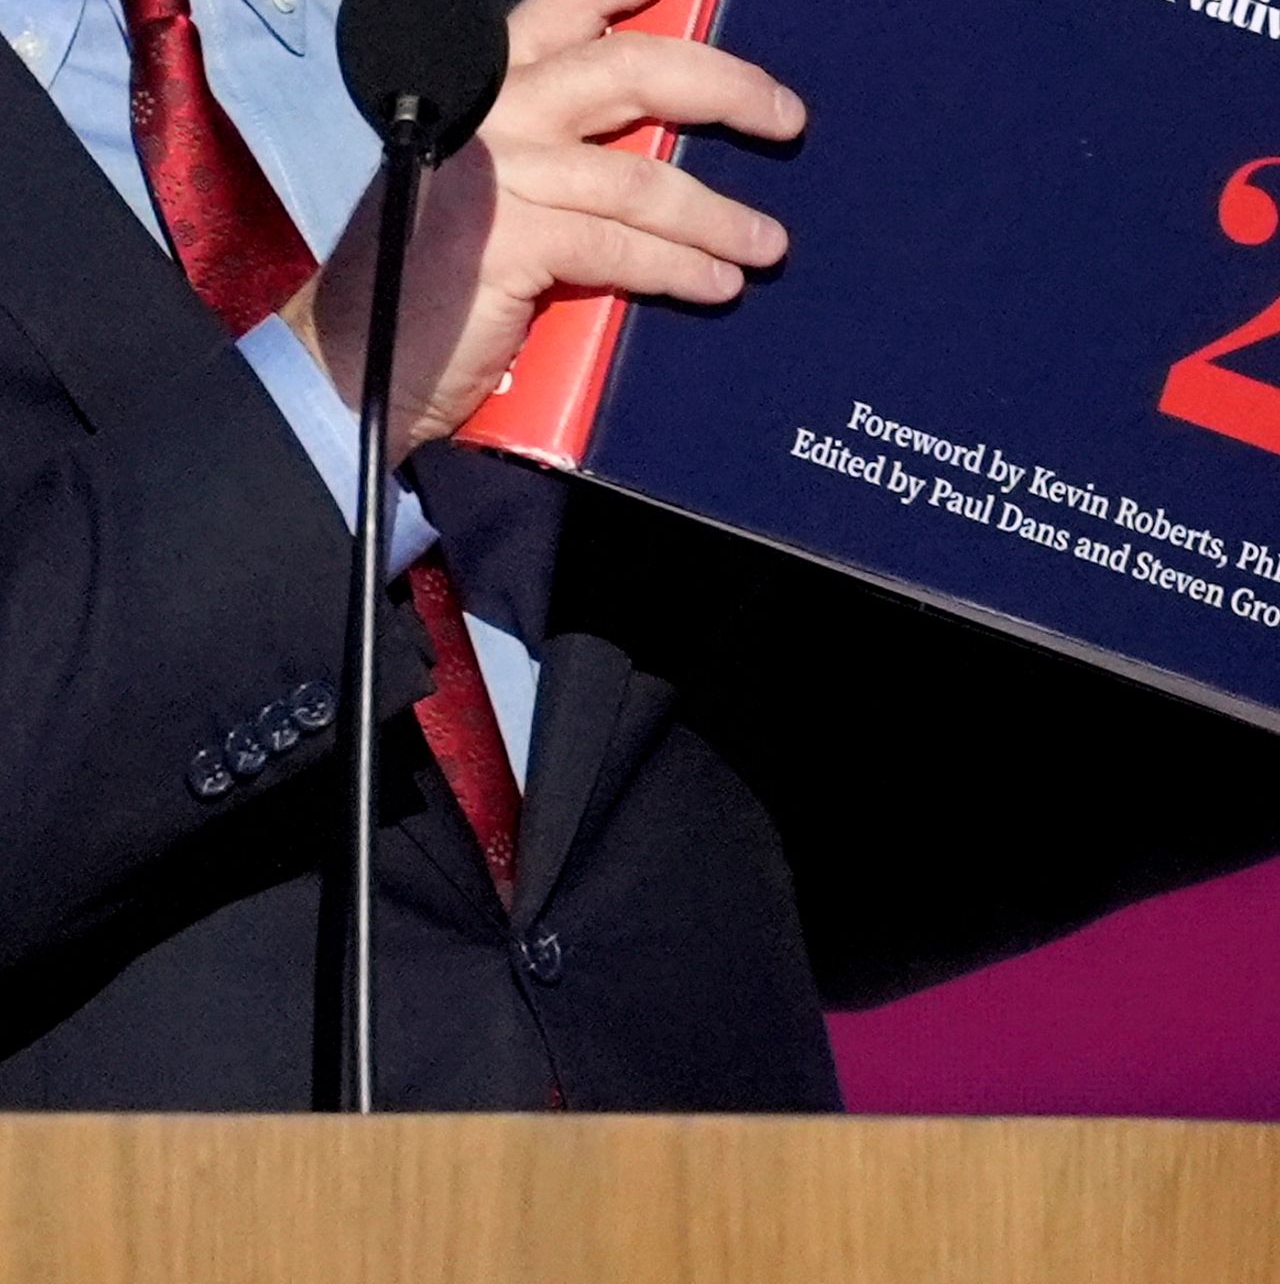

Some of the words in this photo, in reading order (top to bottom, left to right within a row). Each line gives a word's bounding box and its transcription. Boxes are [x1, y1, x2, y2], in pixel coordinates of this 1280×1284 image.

[790, 427, 887, 486] Edited
[886, 460, 927, 505] by
[927, 476, 995, 525] Paul
[996, 501, 1071, 552] Dans
[1074, 536, 1132, 574] and
[1131, 551, 1224, 608] Steven
[847, 400, 986, 474] Foreword
[986, 449, 1026, 494] by
[1028, 465, 1109, 520] Kevin
[1114, 496, 1228, 569] Roberts,
